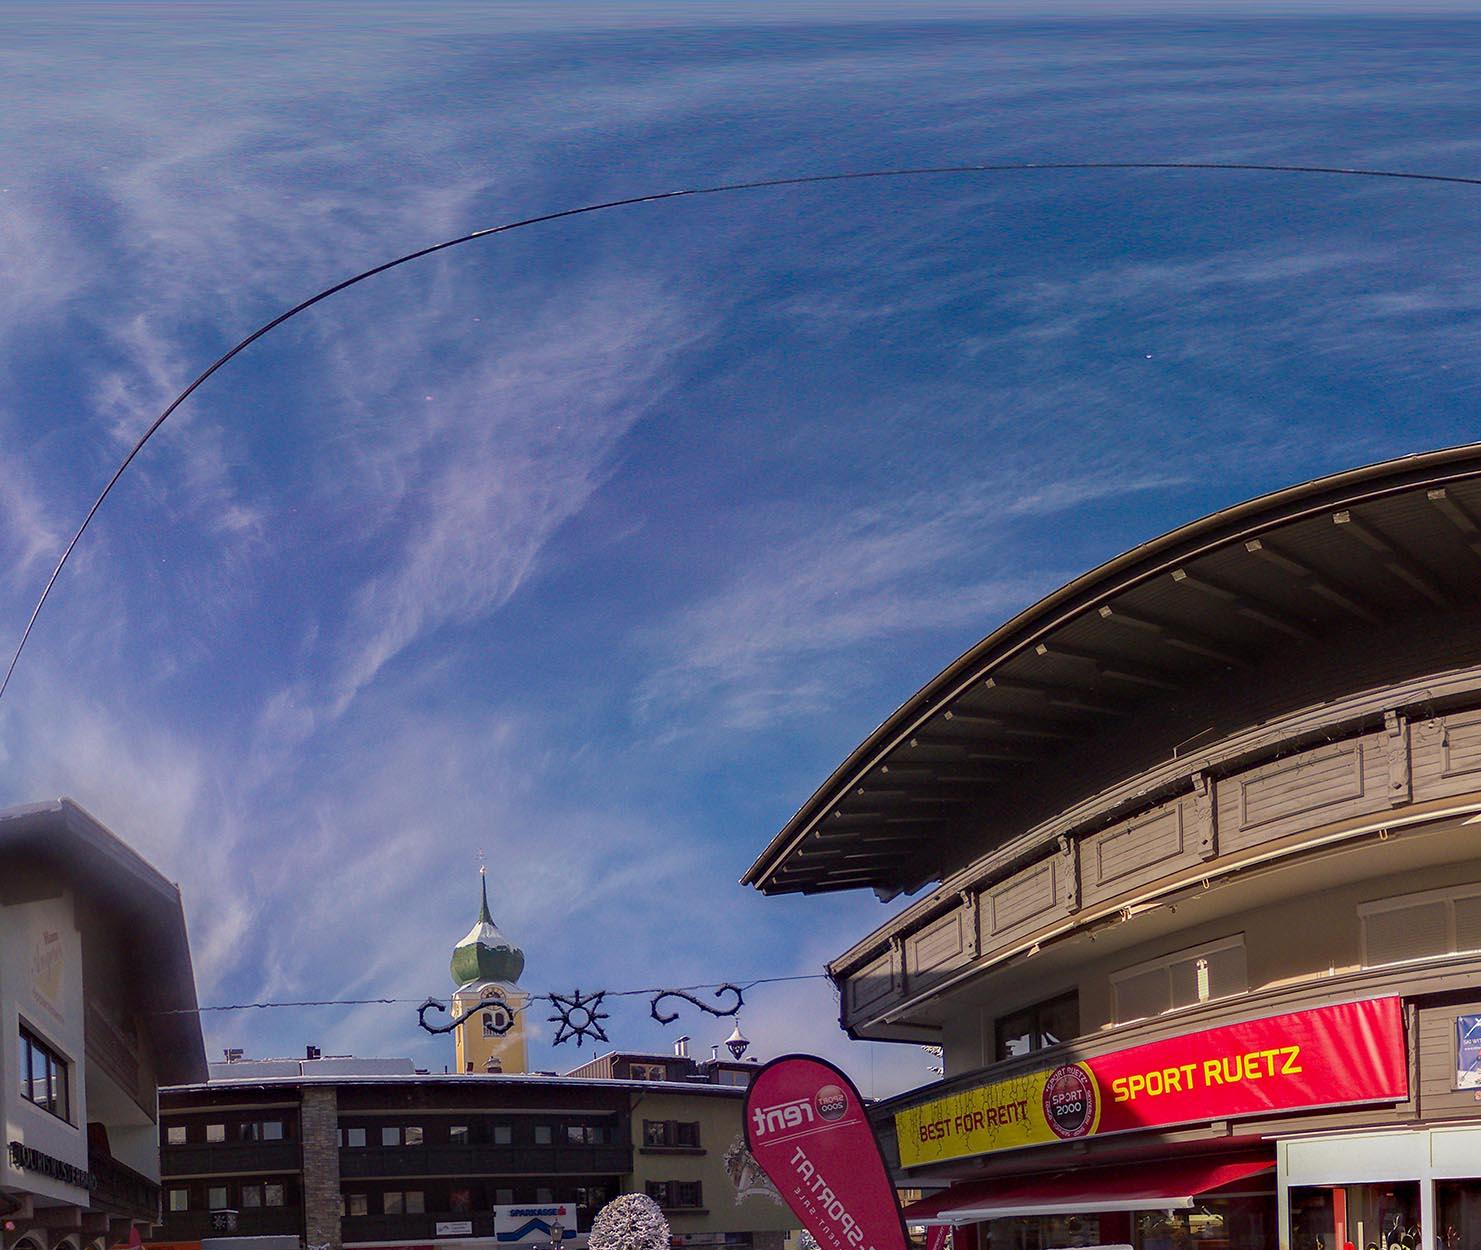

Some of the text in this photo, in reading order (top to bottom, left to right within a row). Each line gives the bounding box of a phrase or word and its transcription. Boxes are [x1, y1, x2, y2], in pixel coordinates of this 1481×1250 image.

[1111, 1045, 1303, 1103] SPORT RUETZ
[1052, 1089, 1083, 1105] SPORT
[1056, 1102, 1082, 1116] 2000
[920, 1100, 1028, 1142] BEST FOR RENT
[510, 1208, 557, 1217] SPARKASSE
